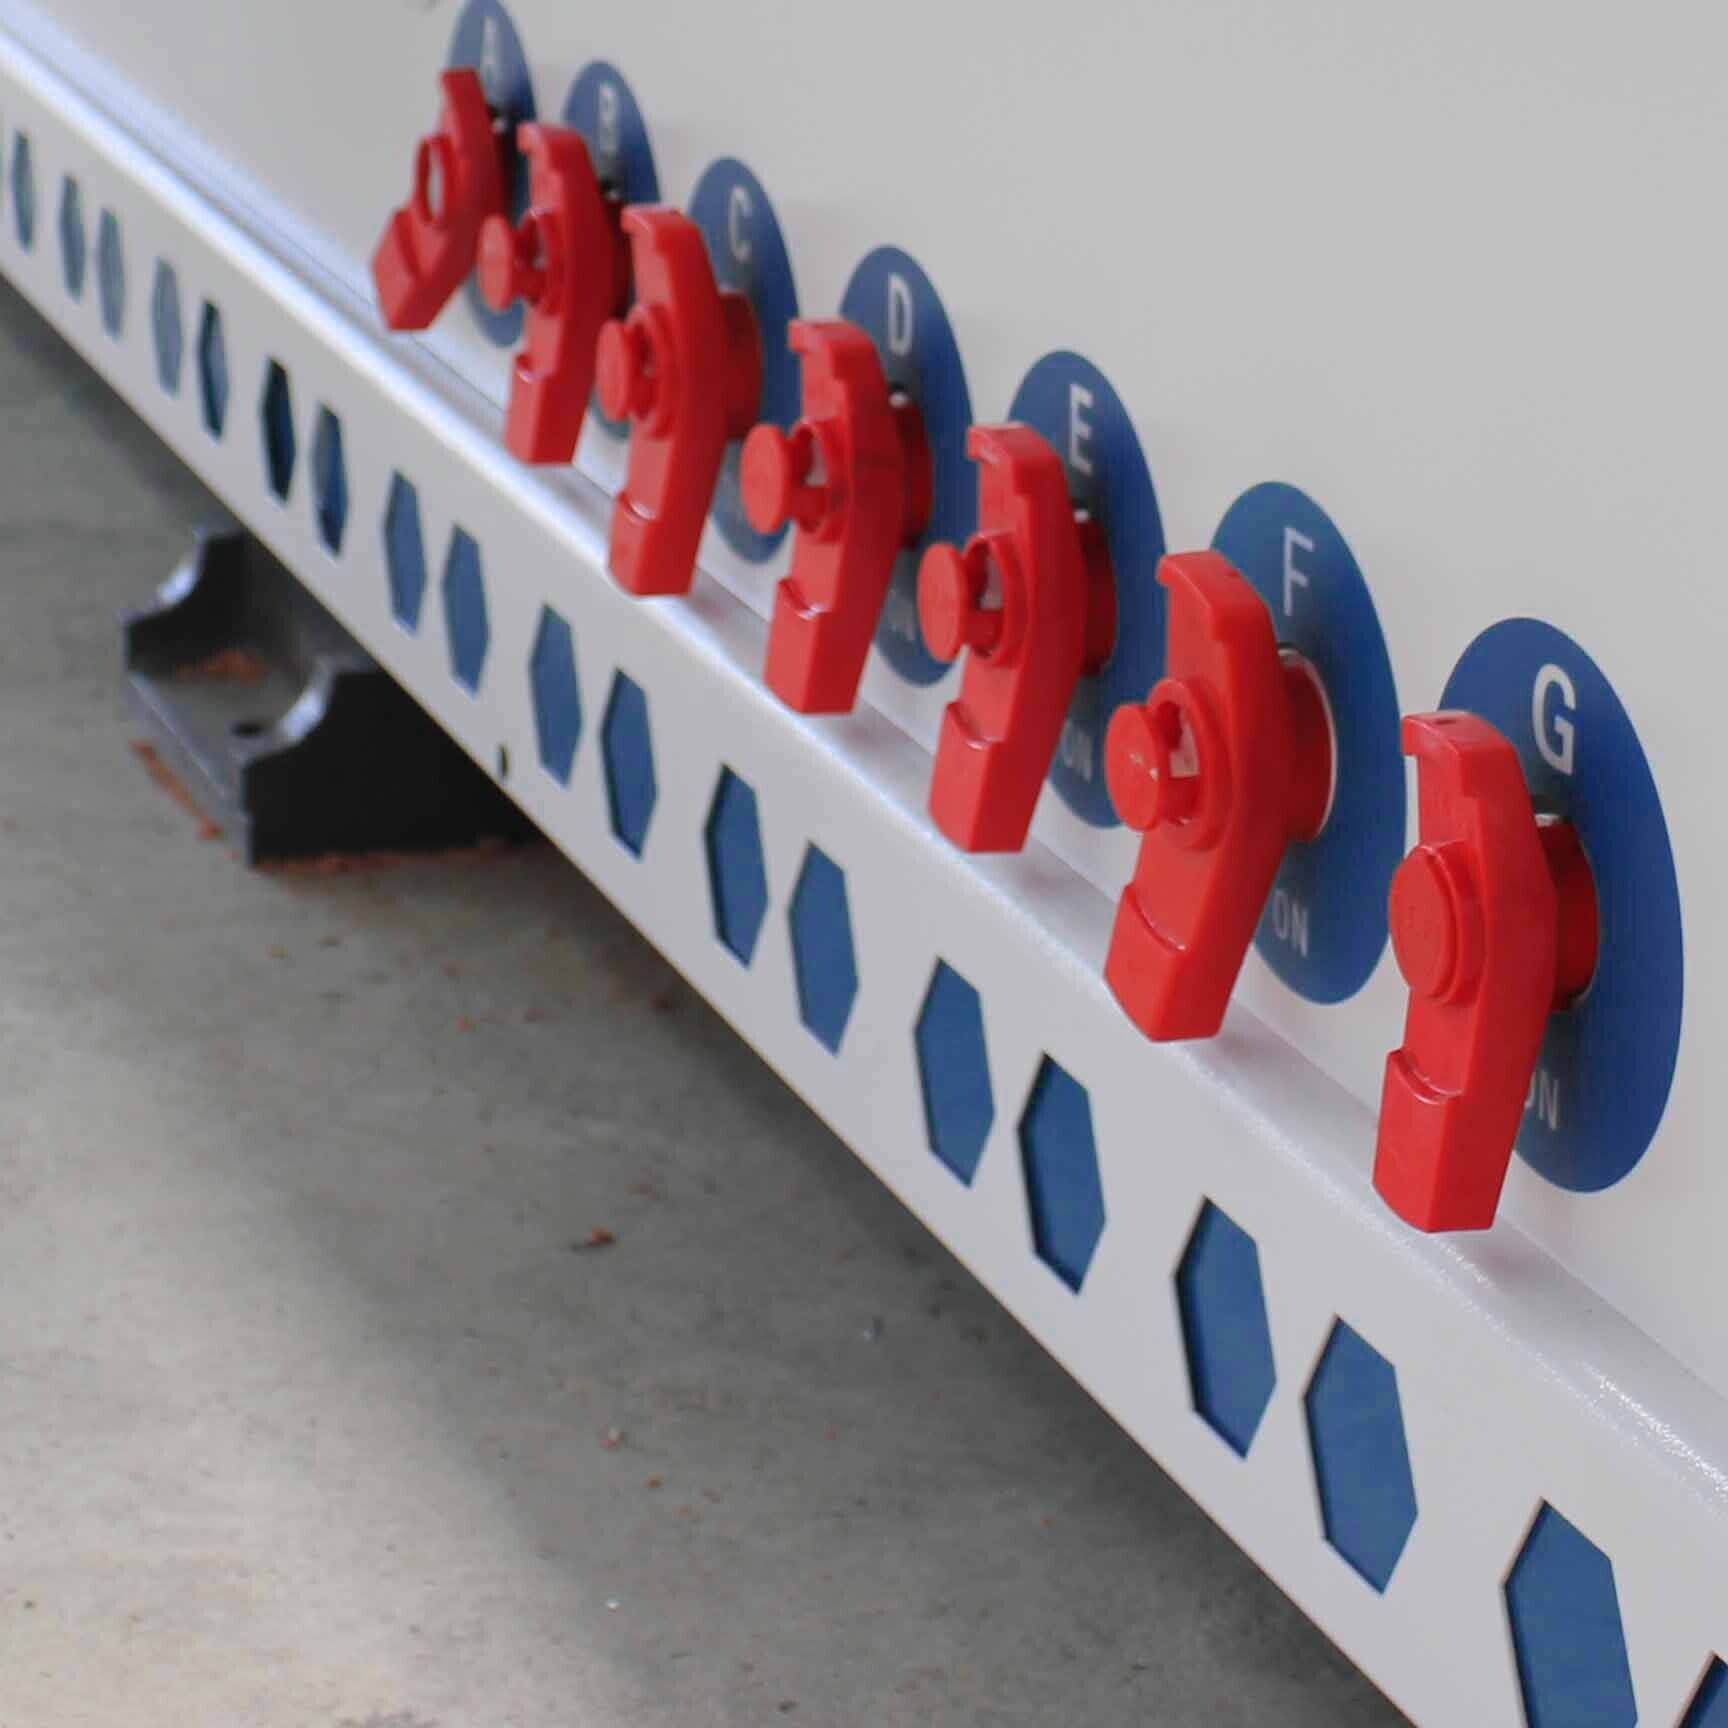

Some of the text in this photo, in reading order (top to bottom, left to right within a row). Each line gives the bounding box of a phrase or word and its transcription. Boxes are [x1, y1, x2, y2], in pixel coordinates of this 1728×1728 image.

[727, 184, 753, 262] C
[887, 273, 914, 356] D
[1069, 382, 1094, 477] E
[1283, 526, 1316, 616] F
[1533, 663, 1576, 775] G
[1272, 888, 1309, 958] ON
